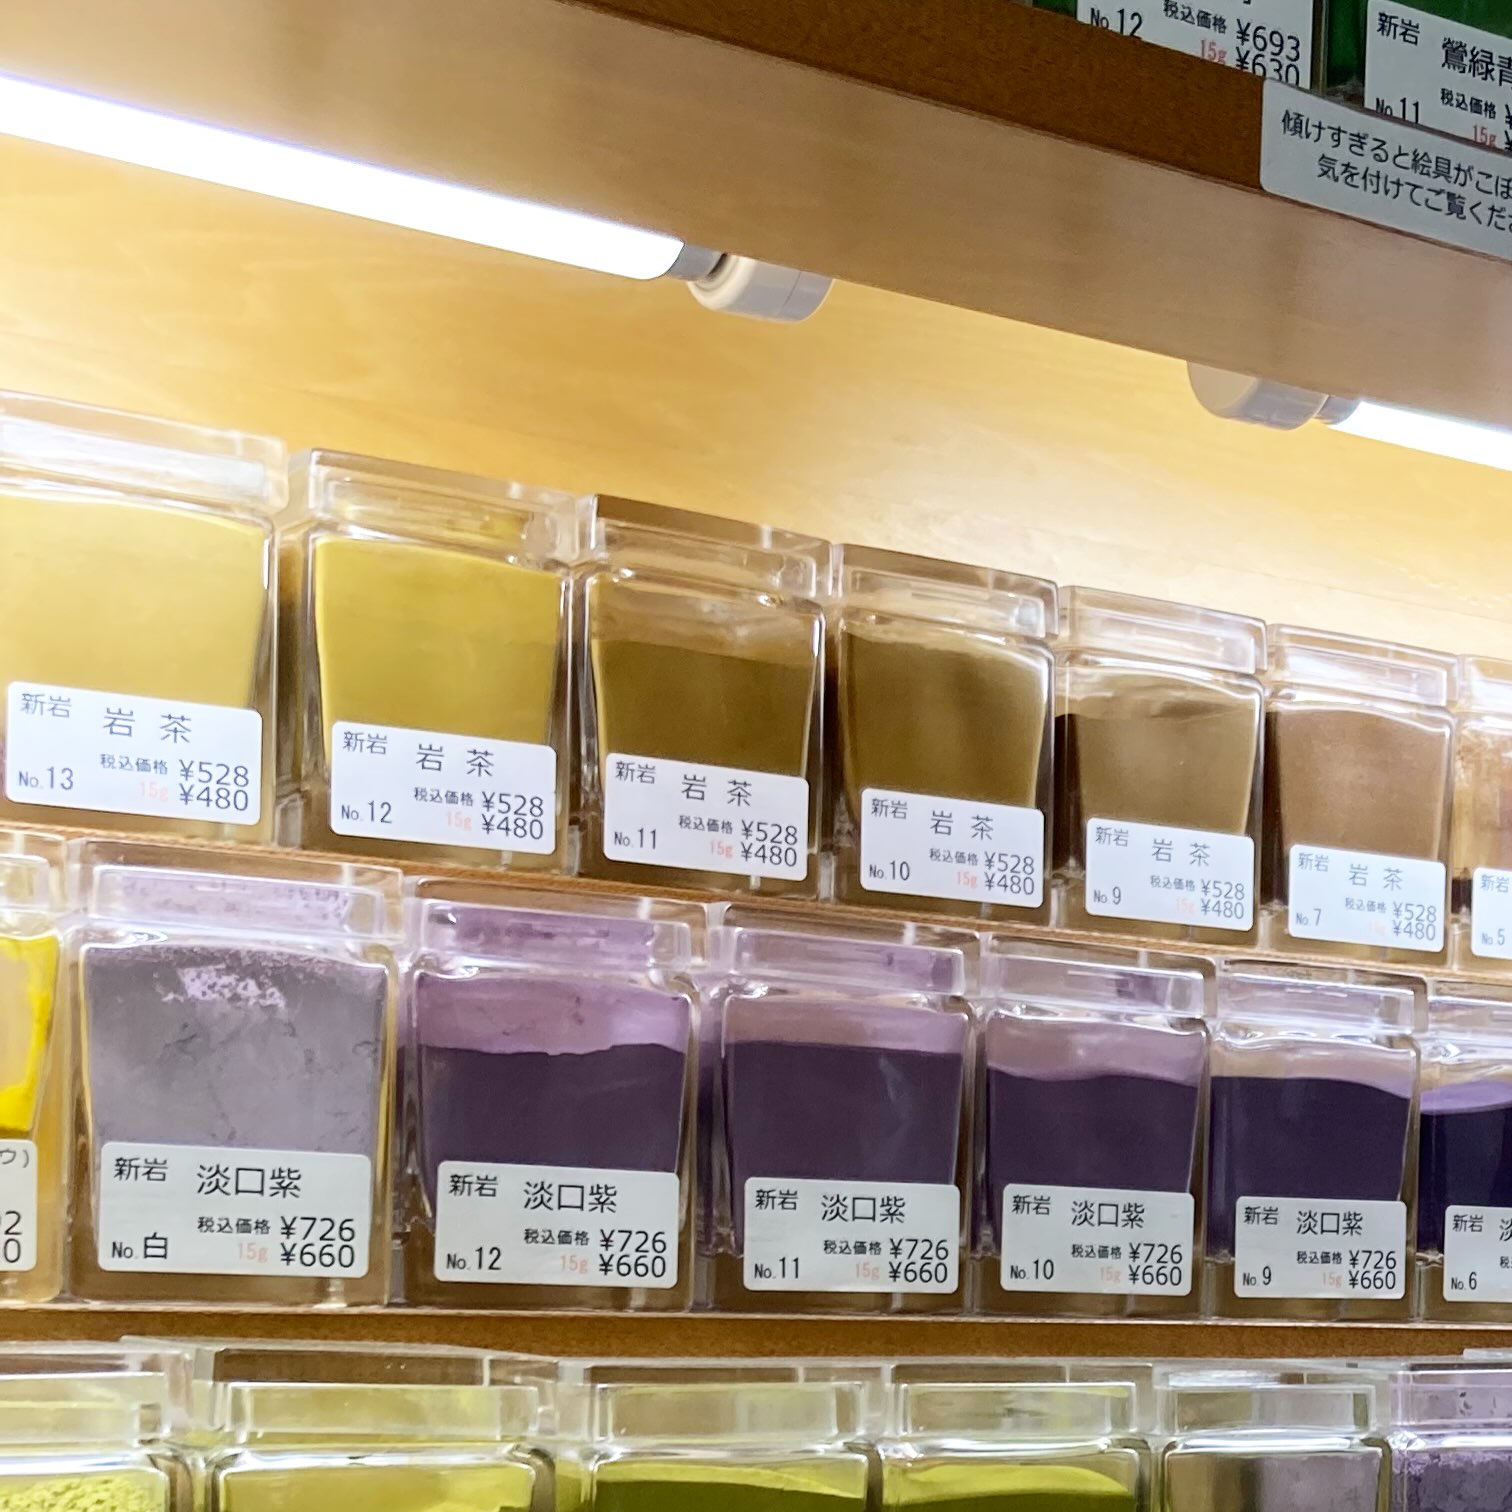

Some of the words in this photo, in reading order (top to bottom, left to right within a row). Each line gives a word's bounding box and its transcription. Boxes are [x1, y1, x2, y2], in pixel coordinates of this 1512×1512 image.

[1163, 0, 1228, 34] 税込価格
[1236, 18, 1300, 62] ¥693
[1376, 11, 1421, 46] 新岩
[1440, 87, 1497, 120] 税込価格
[20, 692, 71, 718] 新岩
[342, 730, 387, 755] 新岩
[99, 752, 168, 775] 税込価格
[177, 758, 249, 788] ¥528
[615, 760, 655, 784] 新岩
[179, 784, 249, 811] ¥480
[413, 786, 473, 806] 税込価格
[480, 790, 544, 824] ¥528
[481, 816, 544, 840] ¥480
[678, 814, 733, 834] 税込価格
[740, 818, 798, 852] ¥528
[1094, 825, 1128, 847] 新岩
[740, 844, 797, 867] ¥480
[983, 850, 1035, 881] ¥528
[984, 874, 1035, 895] ¥480
[1200, 878, 1245, 901] ¥528
[113, 1156, 168, 1182] 新岩
[196, 1163, 301, 1198] 淡口紫
[448, 1173, 497, 1197] 新岩
[523, 1180, 617, 1213] 淡口紫
[754, 1187, 798, 1210] 新岩
[820, 1193, 905, 1224] 淡口紫
[196, 1215, 271, 1235] 税込価格
[279, 1215, 355, 1242] ¥726
[1243, 1205, 1278, 1225] 新岩
[1296, 1209, 1363, 1236] 淡口紫
[523, 1227, 589, 1246] 税込価格
[599, 1228, 667, 1254] ¥726
[888, 1237, 949, 1261] ¥726
[280, 1241, 355, 1268] ¥660
[598, 1252, 666, 1278] ¥660
[1348, 1249, 1397, 1270] ¥726
[1347, 1270, 1396, 1290] ¥660
